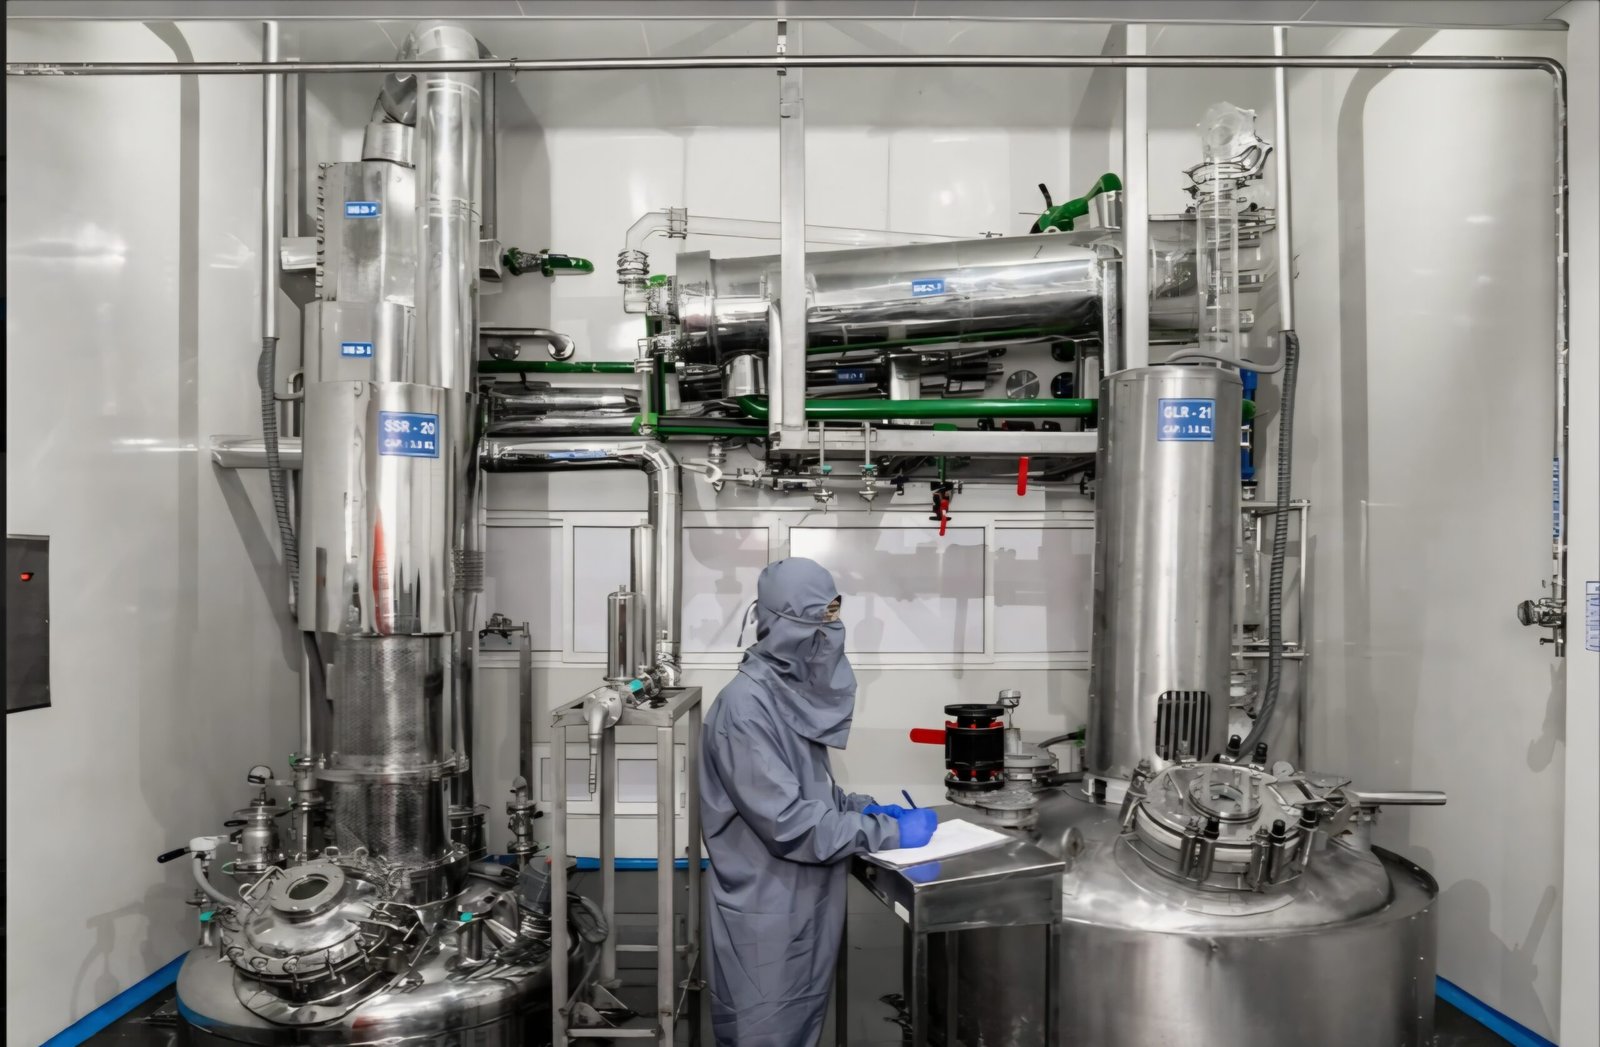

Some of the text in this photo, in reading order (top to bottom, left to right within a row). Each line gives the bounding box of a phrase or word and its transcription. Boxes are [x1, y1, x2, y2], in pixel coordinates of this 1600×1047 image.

[1199, 406, 1211, 419] 21
[384, 419, 410, 433] SSR
[420, 421, 435, 435] 20
